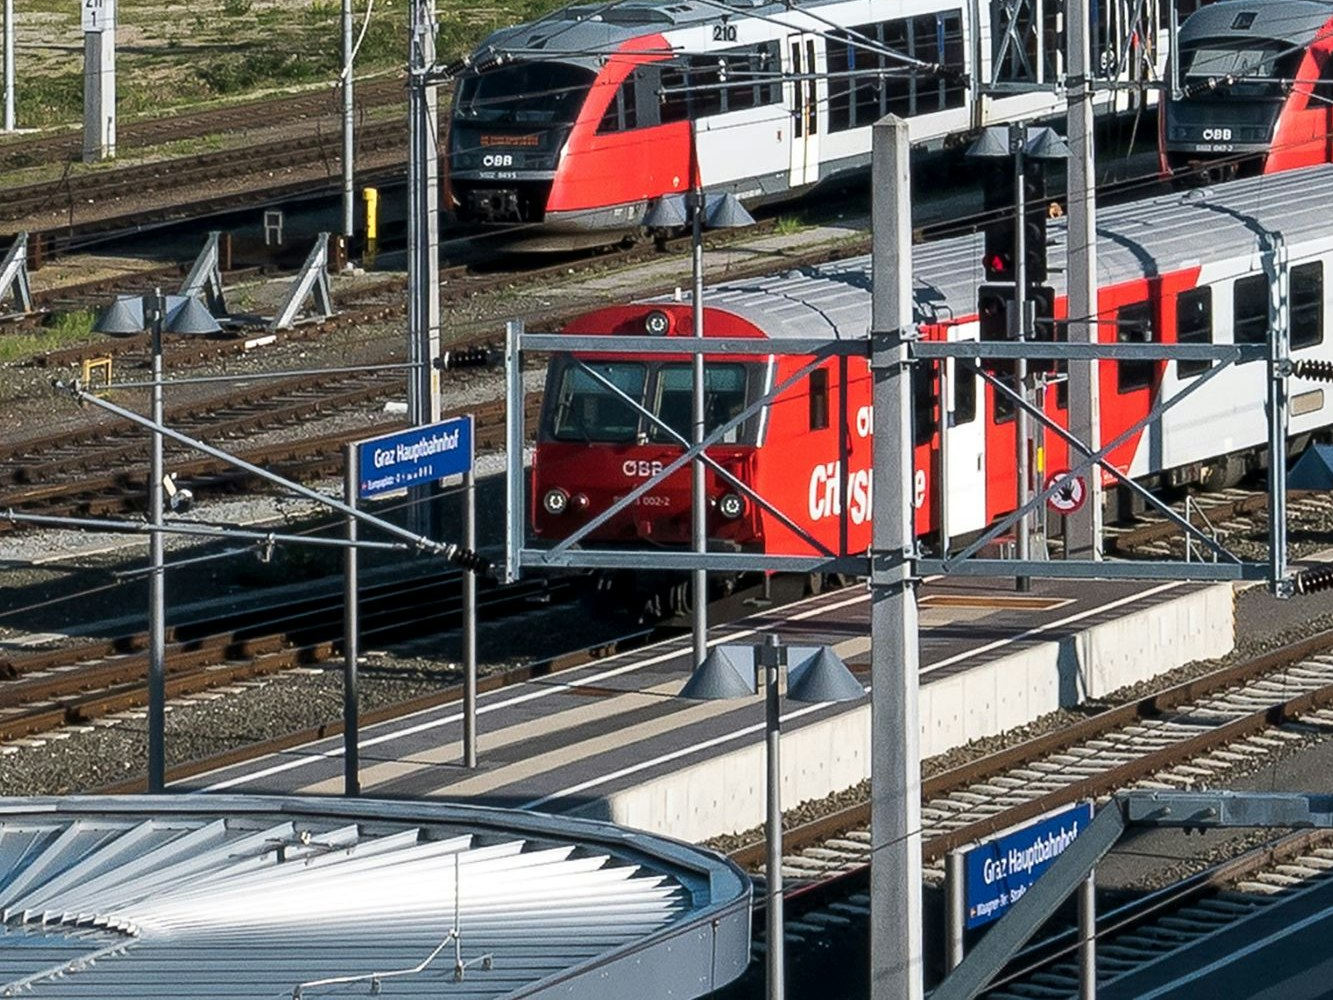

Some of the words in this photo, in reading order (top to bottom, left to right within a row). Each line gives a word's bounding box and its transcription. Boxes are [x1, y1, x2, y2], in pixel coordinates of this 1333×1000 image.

[91, 11, 97, 27] 1
[713, 25, 737, 41] 210
[483, 155, 513, 167] ÖBB
[374, 447, 396, 468] Graz
[397, 428, 460, 463] Hauptbahnhof
[984, 858, 1007, 884] Graz
[1008, 820, 1079, 874] Hauptbahnhof
